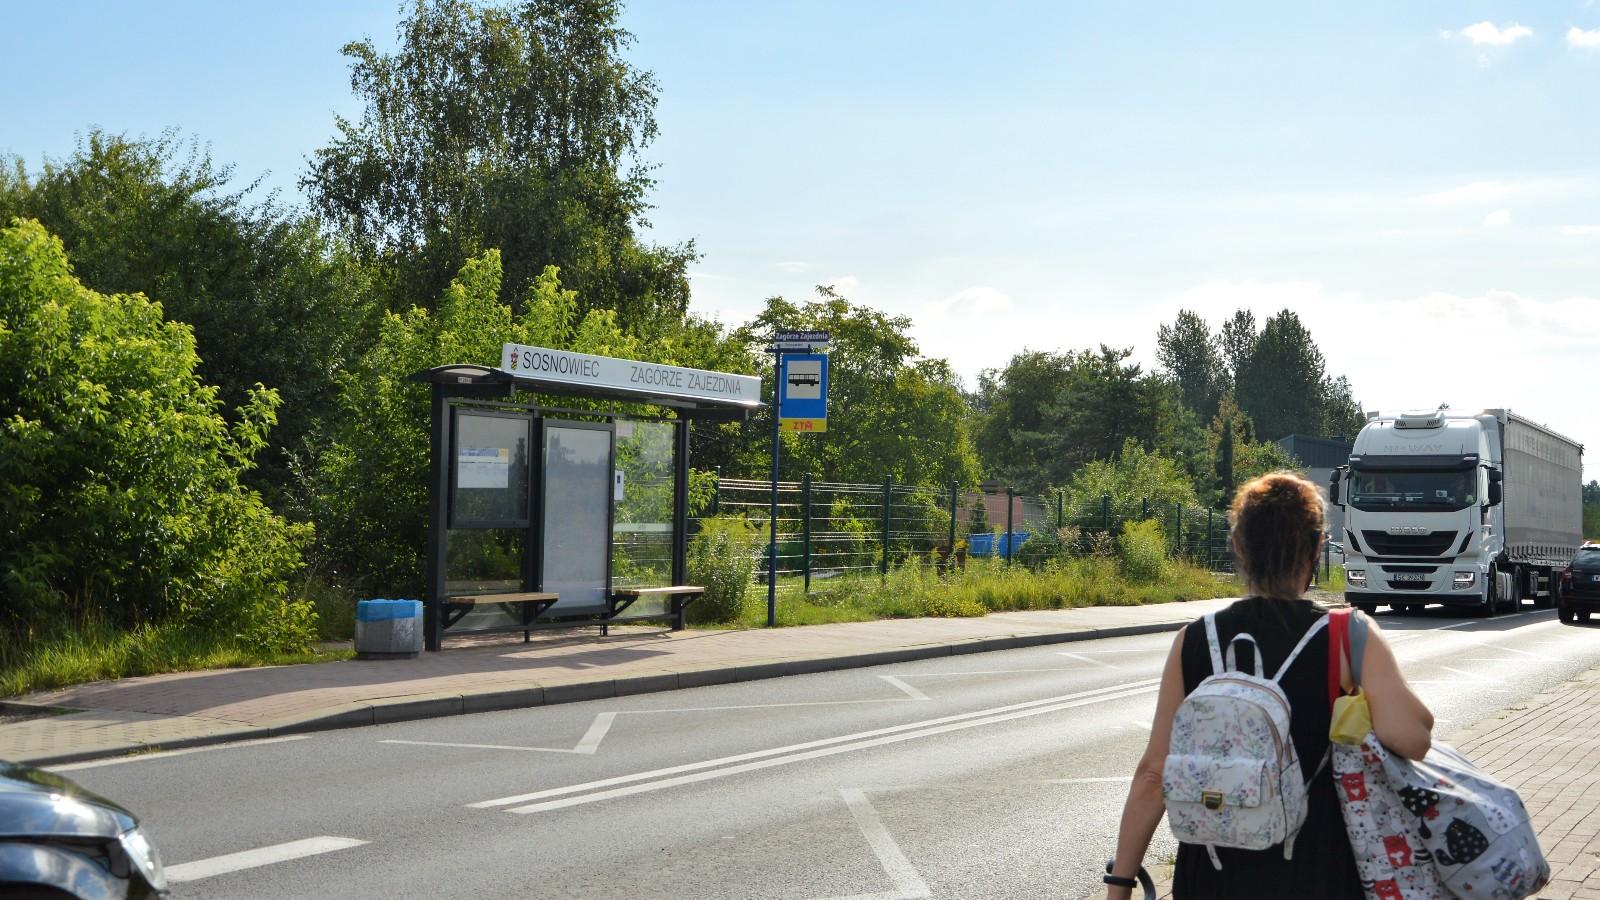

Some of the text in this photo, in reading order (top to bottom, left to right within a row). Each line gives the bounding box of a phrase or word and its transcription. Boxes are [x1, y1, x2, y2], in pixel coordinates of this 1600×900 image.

[522, 351, 742, 395] SOSNOWIEC ZAGÓRZE ZAJEZDNIA
